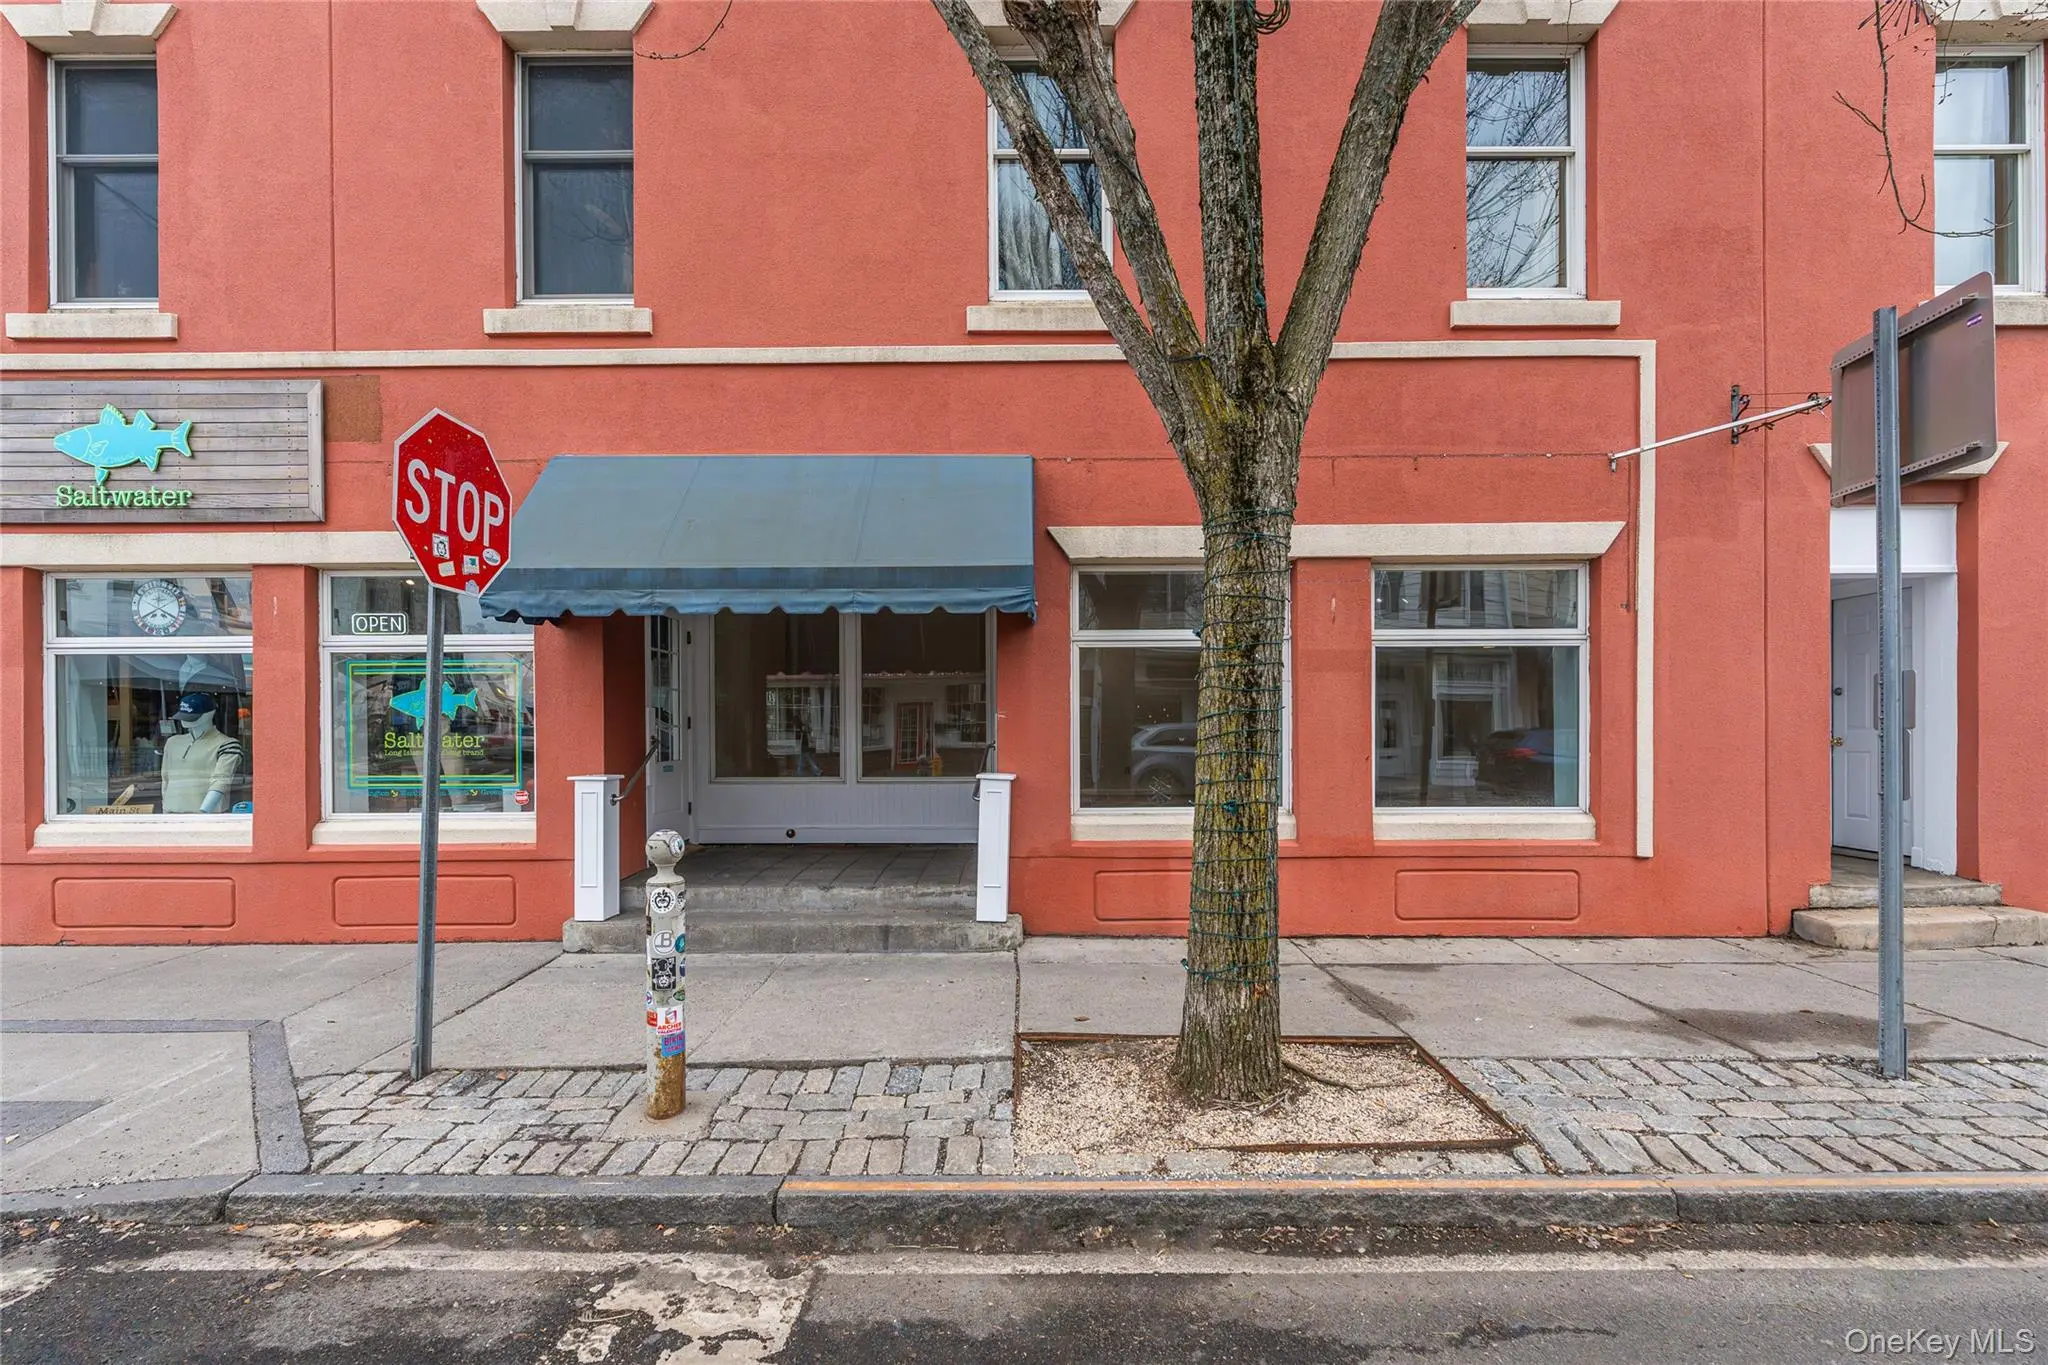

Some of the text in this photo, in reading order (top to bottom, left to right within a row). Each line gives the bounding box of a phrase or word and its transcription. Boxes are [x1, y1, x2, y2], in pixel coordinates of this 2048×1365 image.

[56, 484, 193, 508] Saltwater
[405, 459, 504, 547] STOP
[356, 616, 402, 632] OPEN
[384, 731, 485, 749] Saltater
